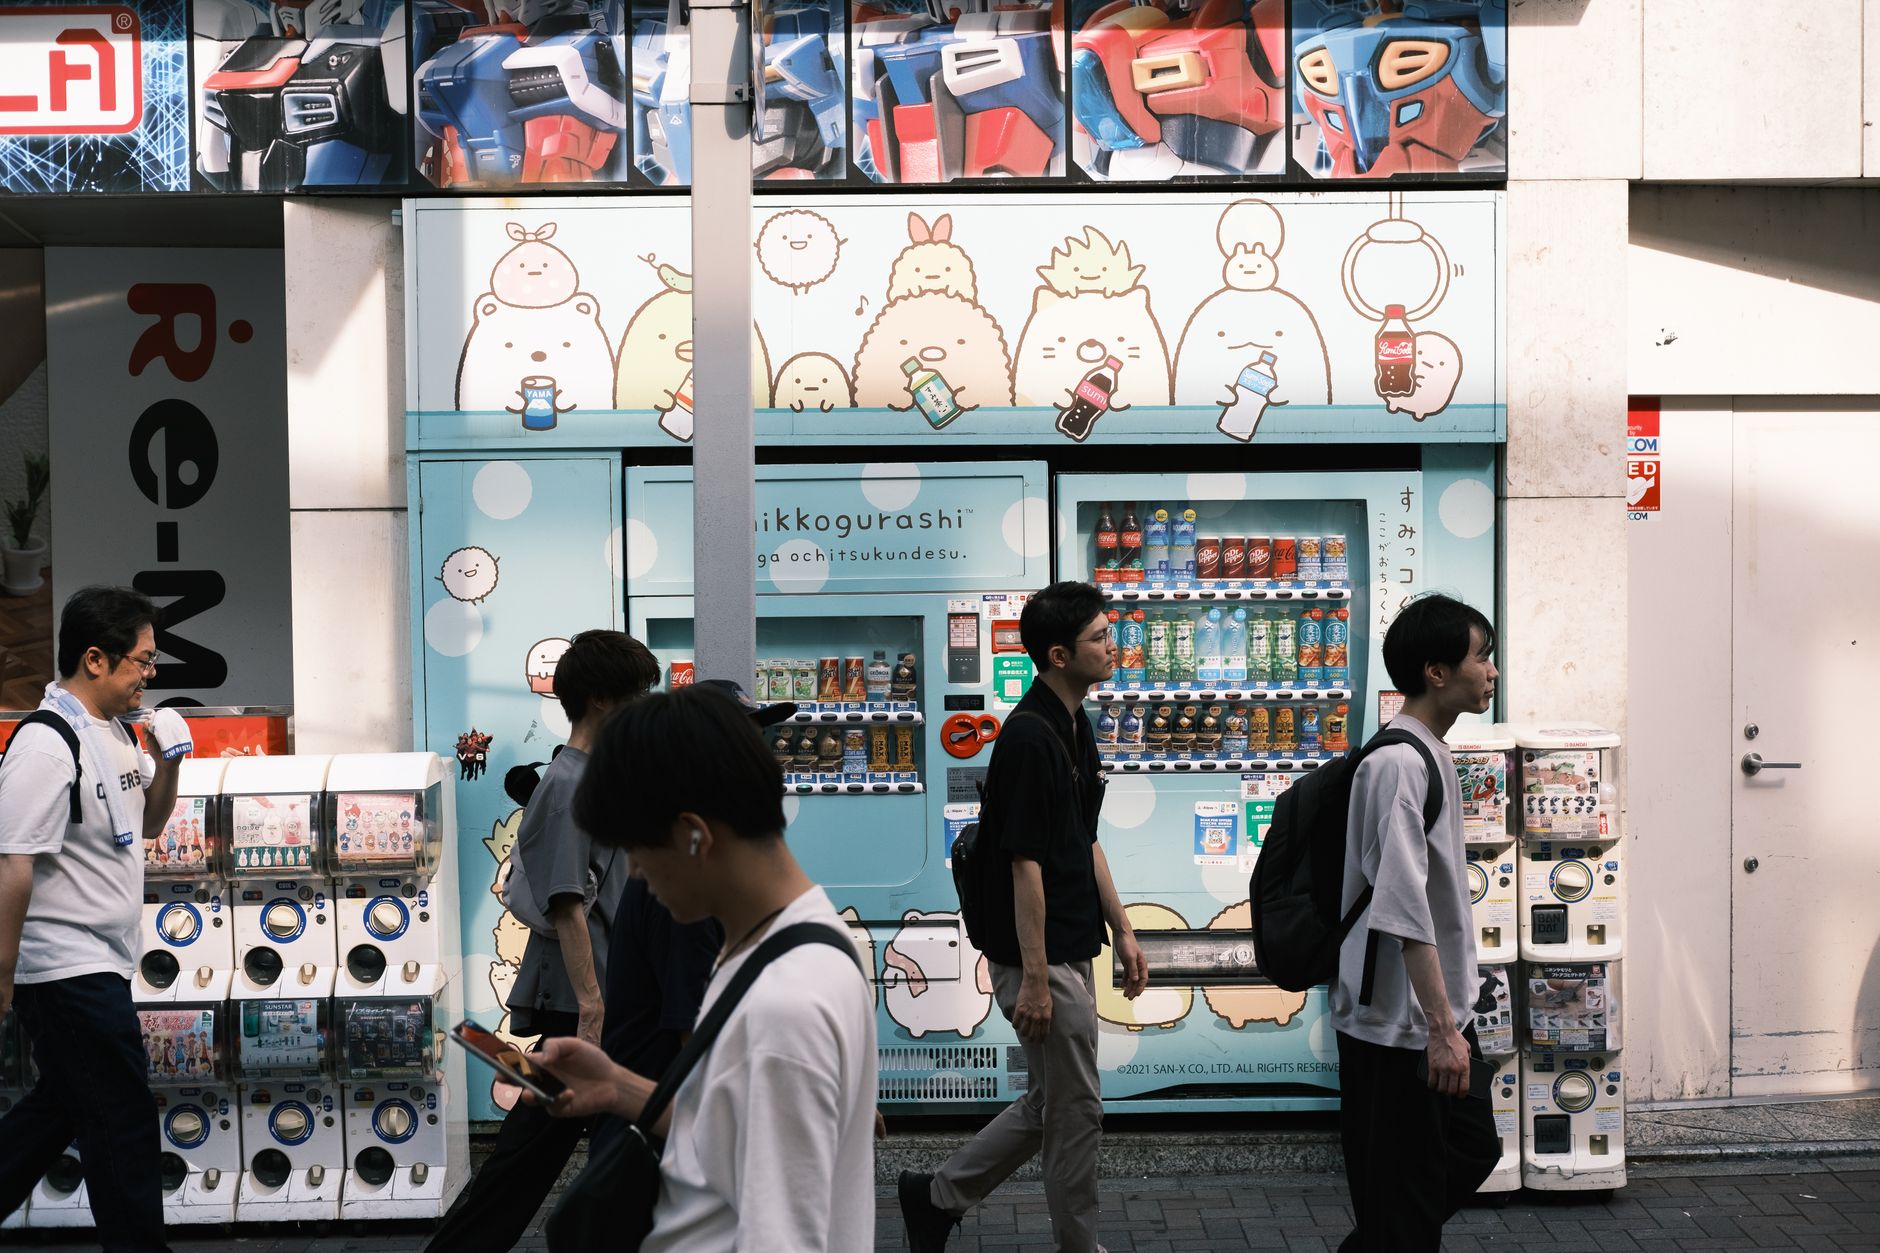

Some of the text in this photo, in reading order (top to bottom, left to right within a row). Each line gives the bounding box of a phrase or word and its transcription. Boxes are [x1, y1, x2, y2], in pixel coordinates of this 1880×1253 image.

[527, 389, 554, 399] YAMA
[1081, 385, 1108, 405] sumi
[1629, 462, 1657, 475] ED
[758, 546, 967, 568] ga ochitsukundesu.
[1199, 551, 1218, 564] Pepper
[1224, 551, 1243, 564] Pepper
[1249, 551, 1269, 564] Pepper
[1117, 1065, 1150, 1075] ©2021
[1153, 1064, 1186, 1074] SAN-X
[1188, 1064, 1209, 1075] CO.,
[1211, 1063, 1234, 1073] LTD.
[1236, 1063, 1254, 1073] ALL
[1257, 1062, 1295, 1073] RIGHTS
